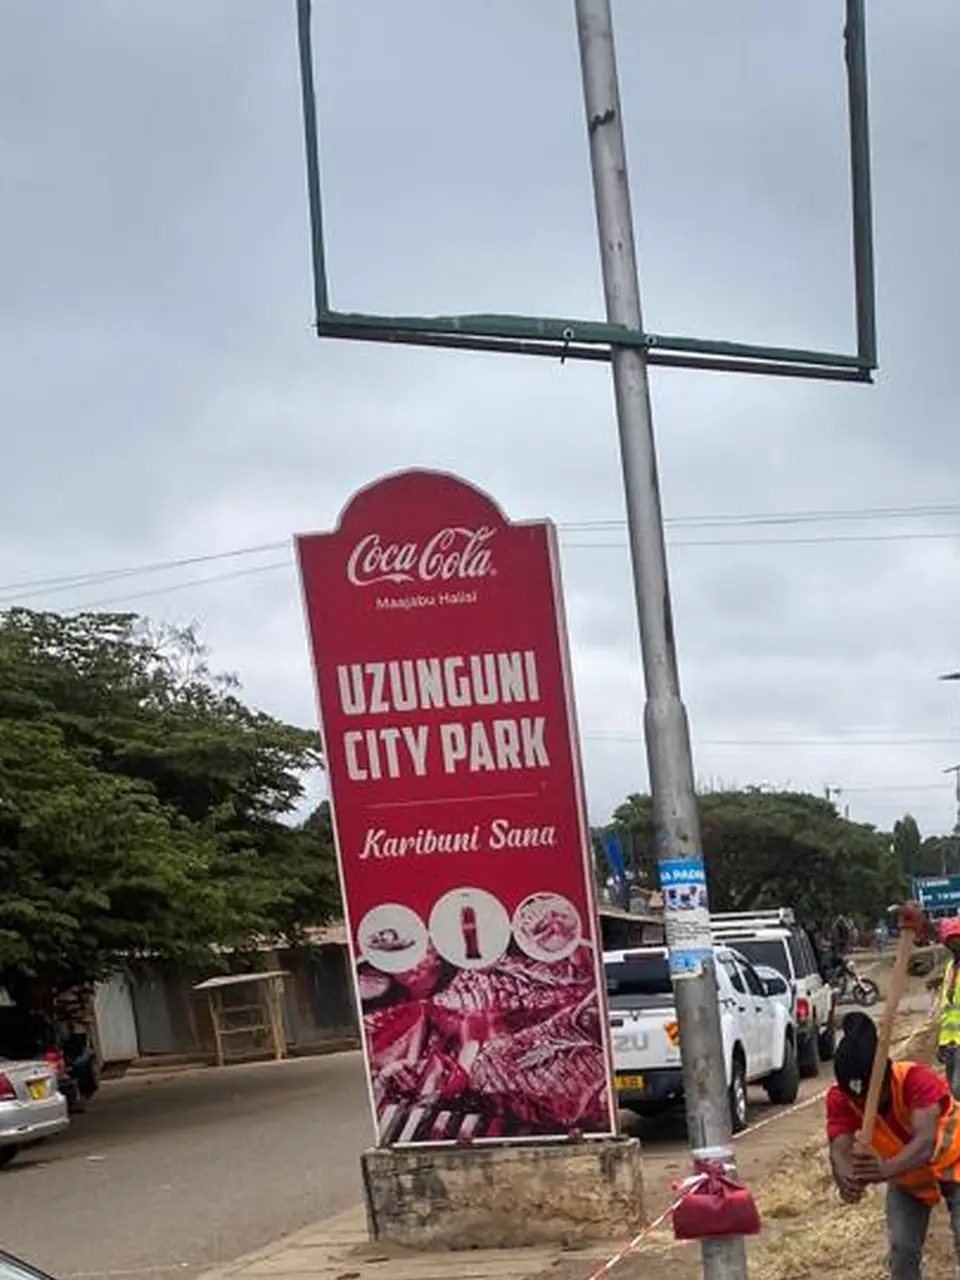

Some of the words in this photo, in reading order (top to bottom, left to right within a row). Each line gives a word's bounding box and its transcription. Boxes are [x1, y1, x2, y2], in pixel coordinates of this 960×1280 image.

[337, 651, 541, 715] UZUNGUNI
[344, 725, 429, 780] CITY
[440, 717, 550, 774] PARK
[359, 826, 480, 859] Karibuni
[489, 819, 556, 850] Sana
